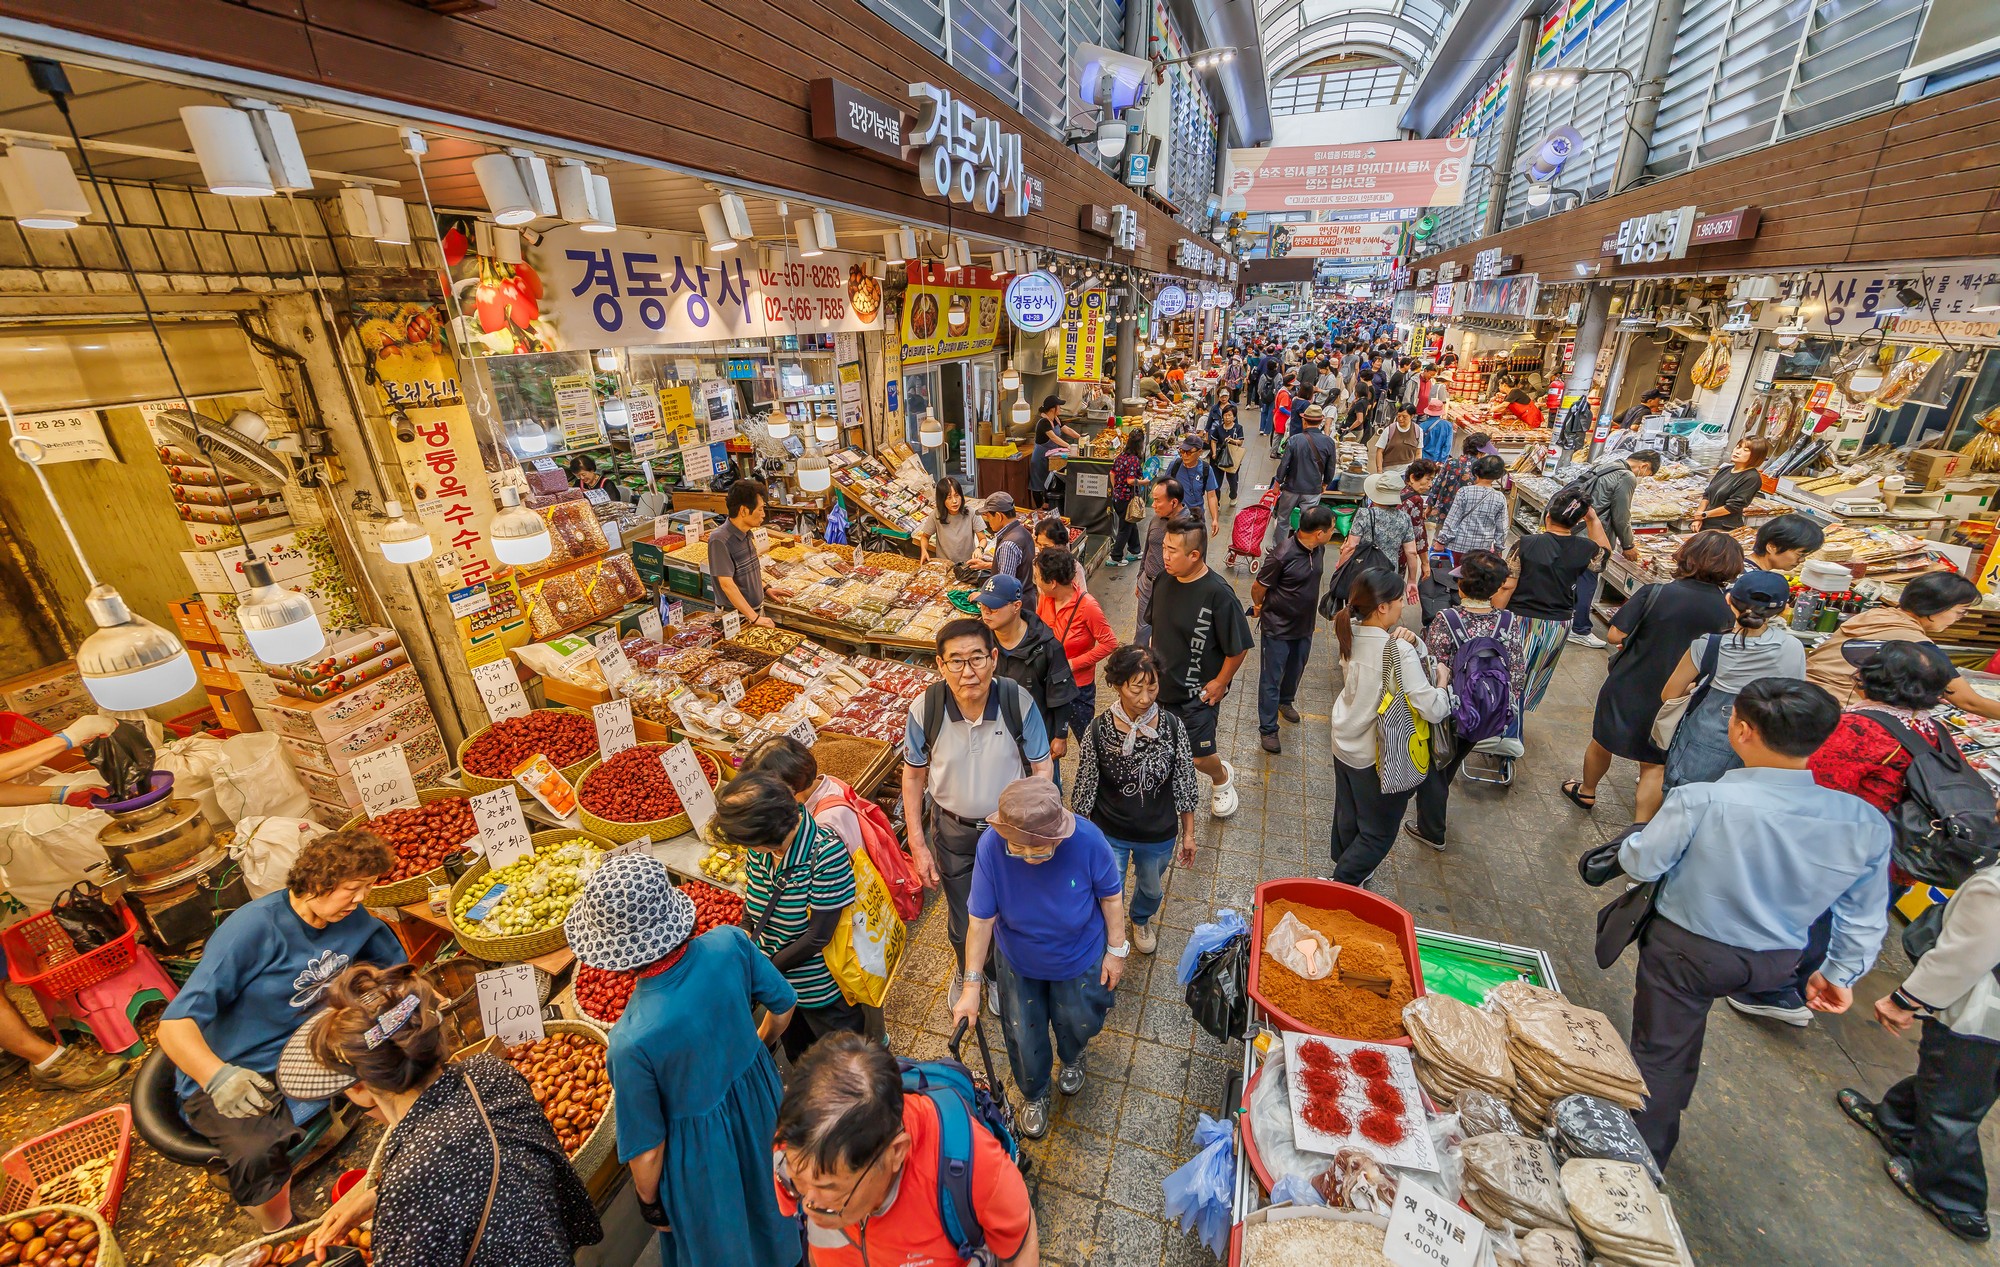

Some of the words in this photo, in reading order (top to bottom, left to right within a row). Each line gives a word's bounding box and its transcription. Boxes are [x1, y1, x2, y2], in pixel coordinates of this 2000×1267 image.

[848, 101, 900, 146] 건강기능식품
[911, 82, 1024, 217] 경동상사
[1319, 226, 1339, 235] 안녕히
[1340, 225, 1361, 233] 가세요
[1617, 206, 1687, 265] 덕성상회
[1695, 219, 1733, 238] T.960-0679
[565, 248, 752, 333] 경동상사
[1012, 295, 1055, 310] 경동상사
[19, 422, 31, 431] 27
[35, 420, 49, 429] 28
[52, 419, 66, 428] 29
[69, 417, 82, 427] 30
[1417, 1223, 1444, 1247] 한국산
[1424, 1208, 1467, 1245] 엿기름
